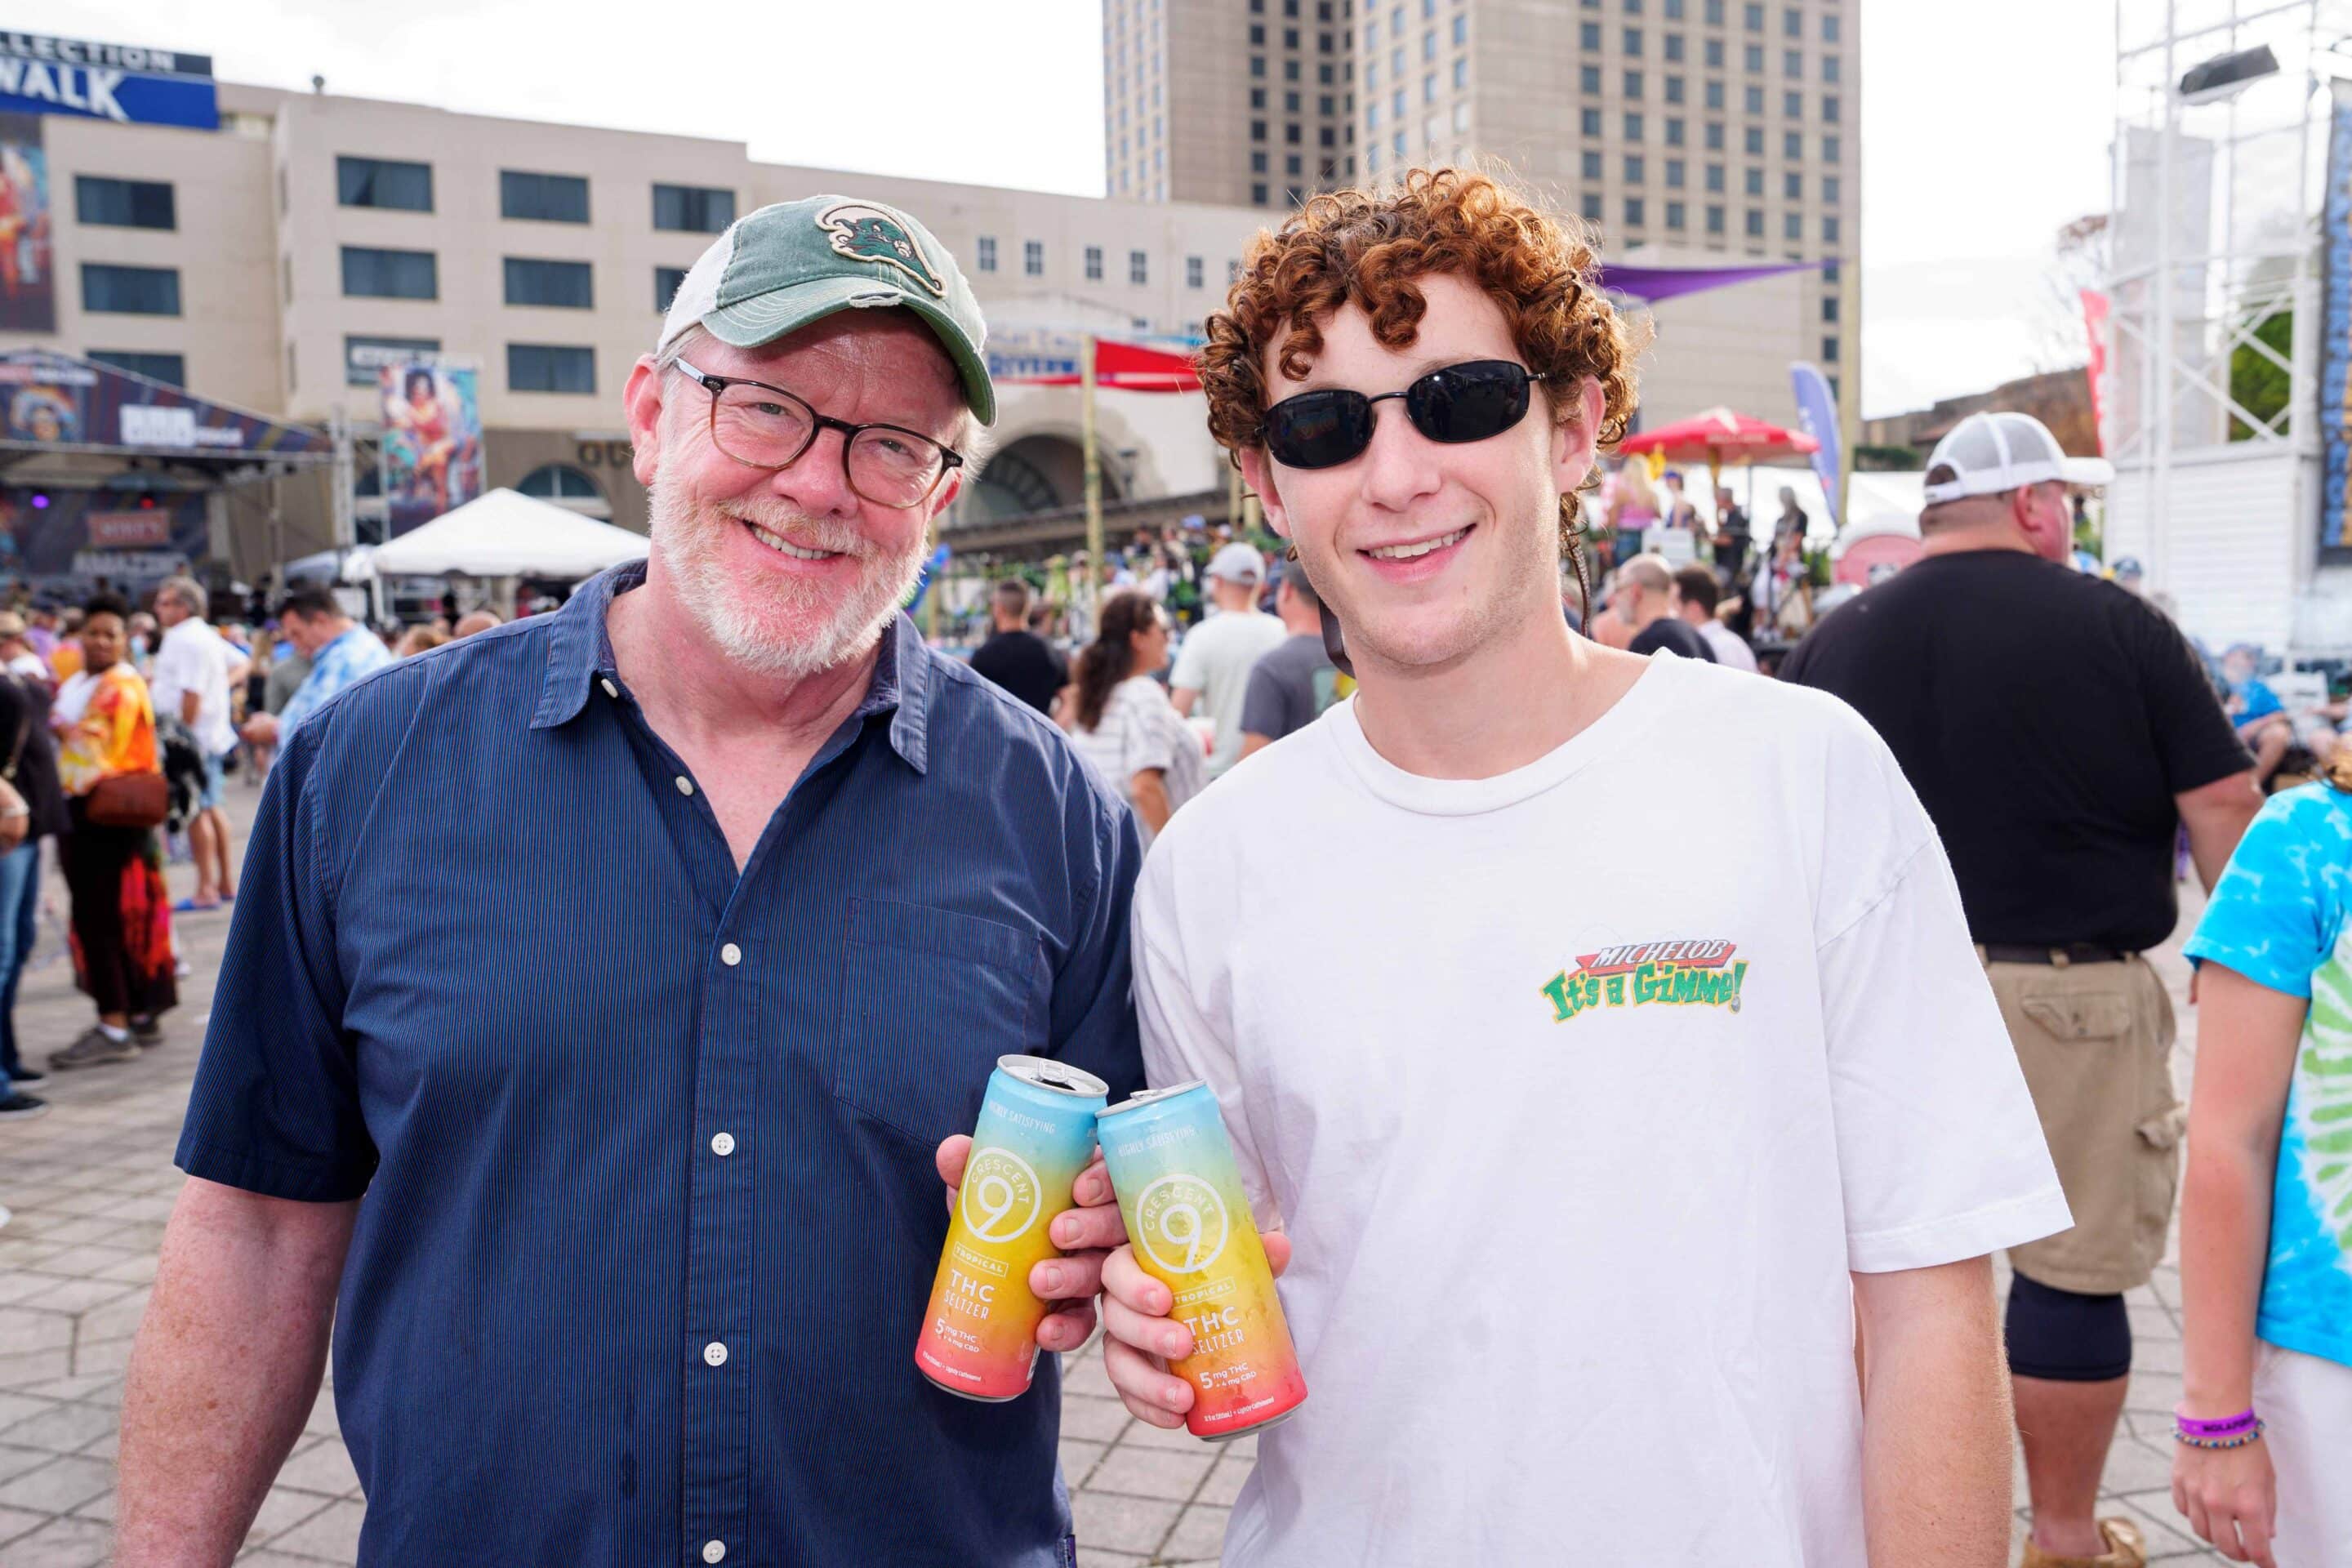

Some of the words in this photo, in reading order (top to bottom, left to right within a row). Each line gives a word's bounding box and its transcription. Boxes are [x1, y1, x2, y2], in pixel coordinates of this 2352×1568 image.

[1591, 939, 1731, 969] MICHELOB
[1540, 969, 1601, 1022] It's
[1606, 973, 1626, 1007] a
[1008, 1110, 1057, 1135] SATISFYING
[1145, 1125, 1196, 1150] SATISFYING
[971, 1158, 1030, 1205] CRESCENT
[978, 1175, 1013, 1235] 9
[1145, 1184, 1215, 1232] CRESCENT
[1160, 1202, 1202, 1269] 9
[956, 1245, 1004, 1273] TROPICAL
[951, 1268, 996, 1303] THC
[1174, 1280, 1231, 1303] TROPICAL
[944, 1289, 990, 1320] SELTZER
[935, 1317, 946, 1334] 5
[959, 1330, 978, 1343] THC
[1183, 1306, 1240, 1337] THC
[964, 1343, 980, 1353] CBD
[1199, 1371, 1214, 1389] 5
[1213, 1370, 1228, 1379] mg
[1228, 1362, 1249, 1374] THC
[1241, 1370, 1257, 1381] CBD
